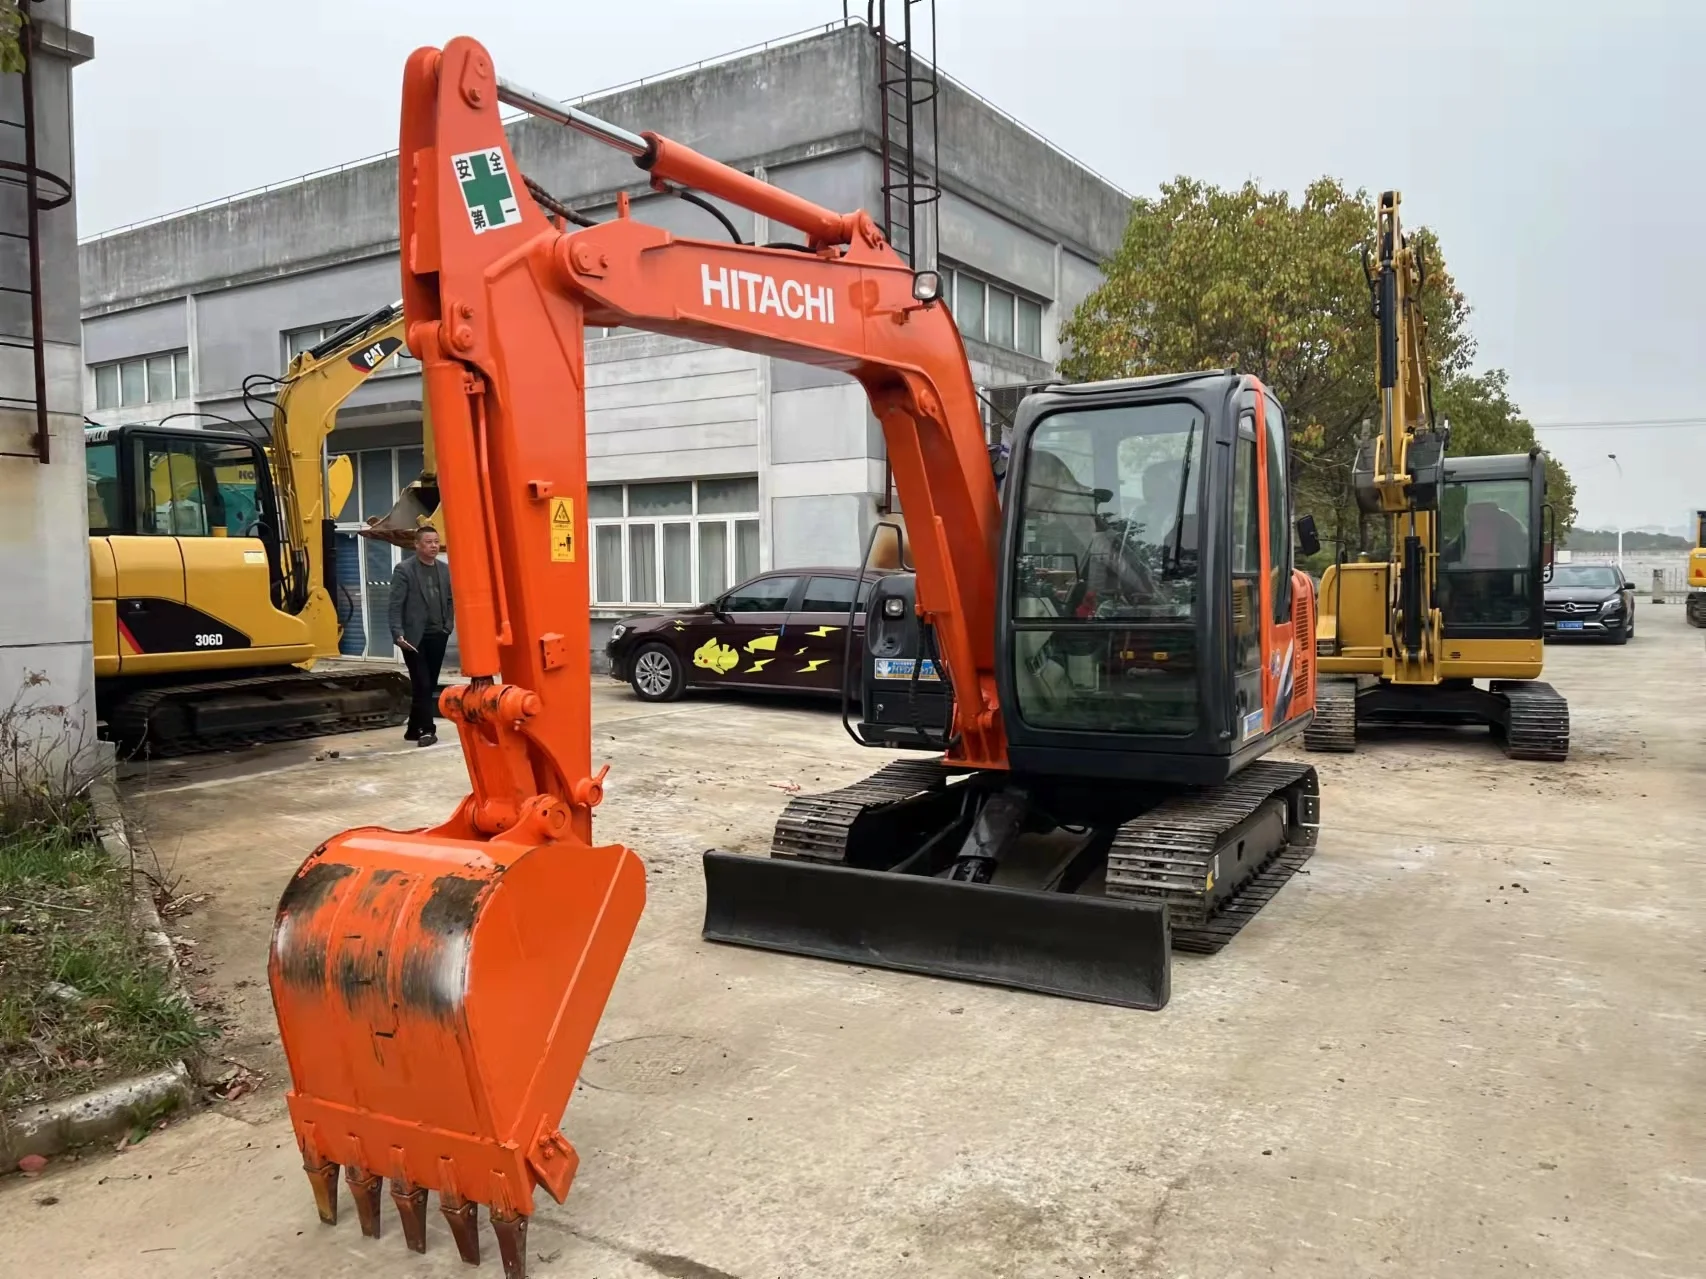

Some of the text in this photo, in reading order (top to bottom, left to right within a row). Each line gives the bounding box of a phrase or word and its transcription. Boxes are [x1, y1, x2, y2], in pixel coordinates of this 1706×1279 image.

[701, 263, 835, 324] HITACHI
[363, 343, 385, 367] CAT
[195, 633, 223, 647] 306D
